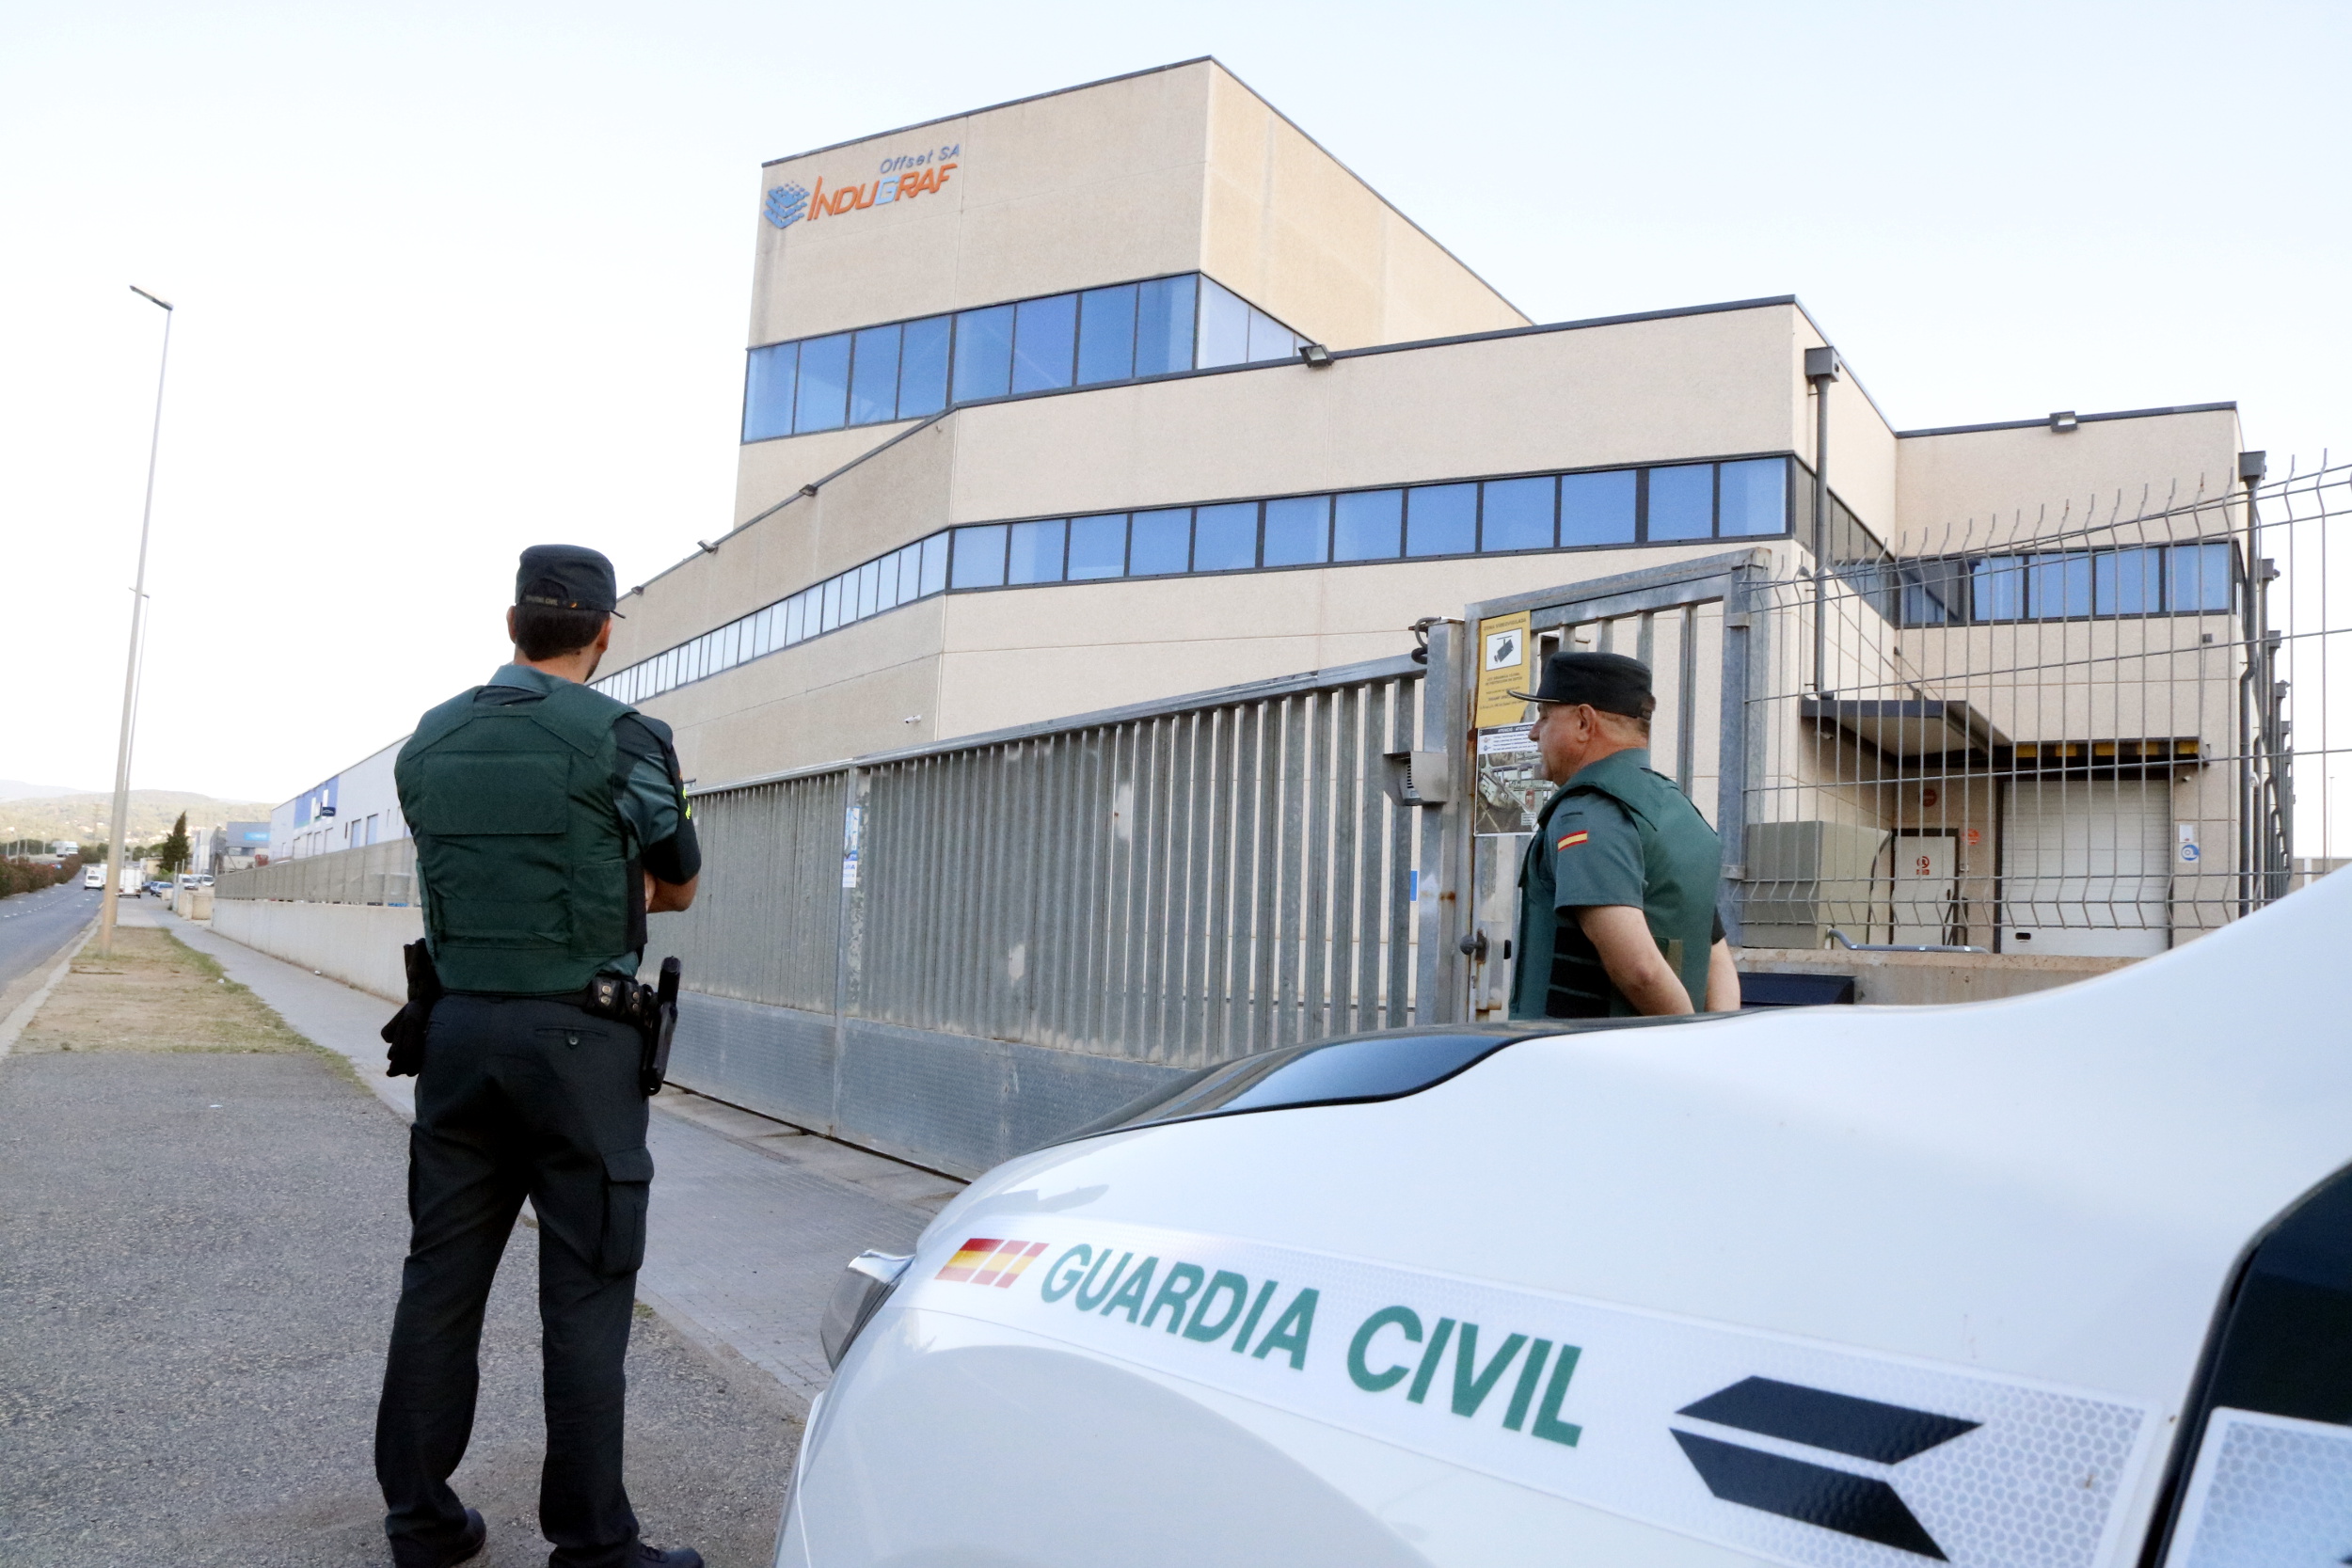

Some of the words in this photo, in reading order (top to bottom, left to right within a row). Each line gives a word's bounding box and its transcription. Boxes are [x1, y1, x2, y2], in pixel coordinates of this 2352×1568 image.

[880, 149, 933, 174] Offset
[938, 143, 960, 161] SA
[806, 163, 958, 221] INDUGRAF
[1041, 1243, 1320, 1371] GUARDIA
[1347, 1306, 1583, 1448] CIVIL
